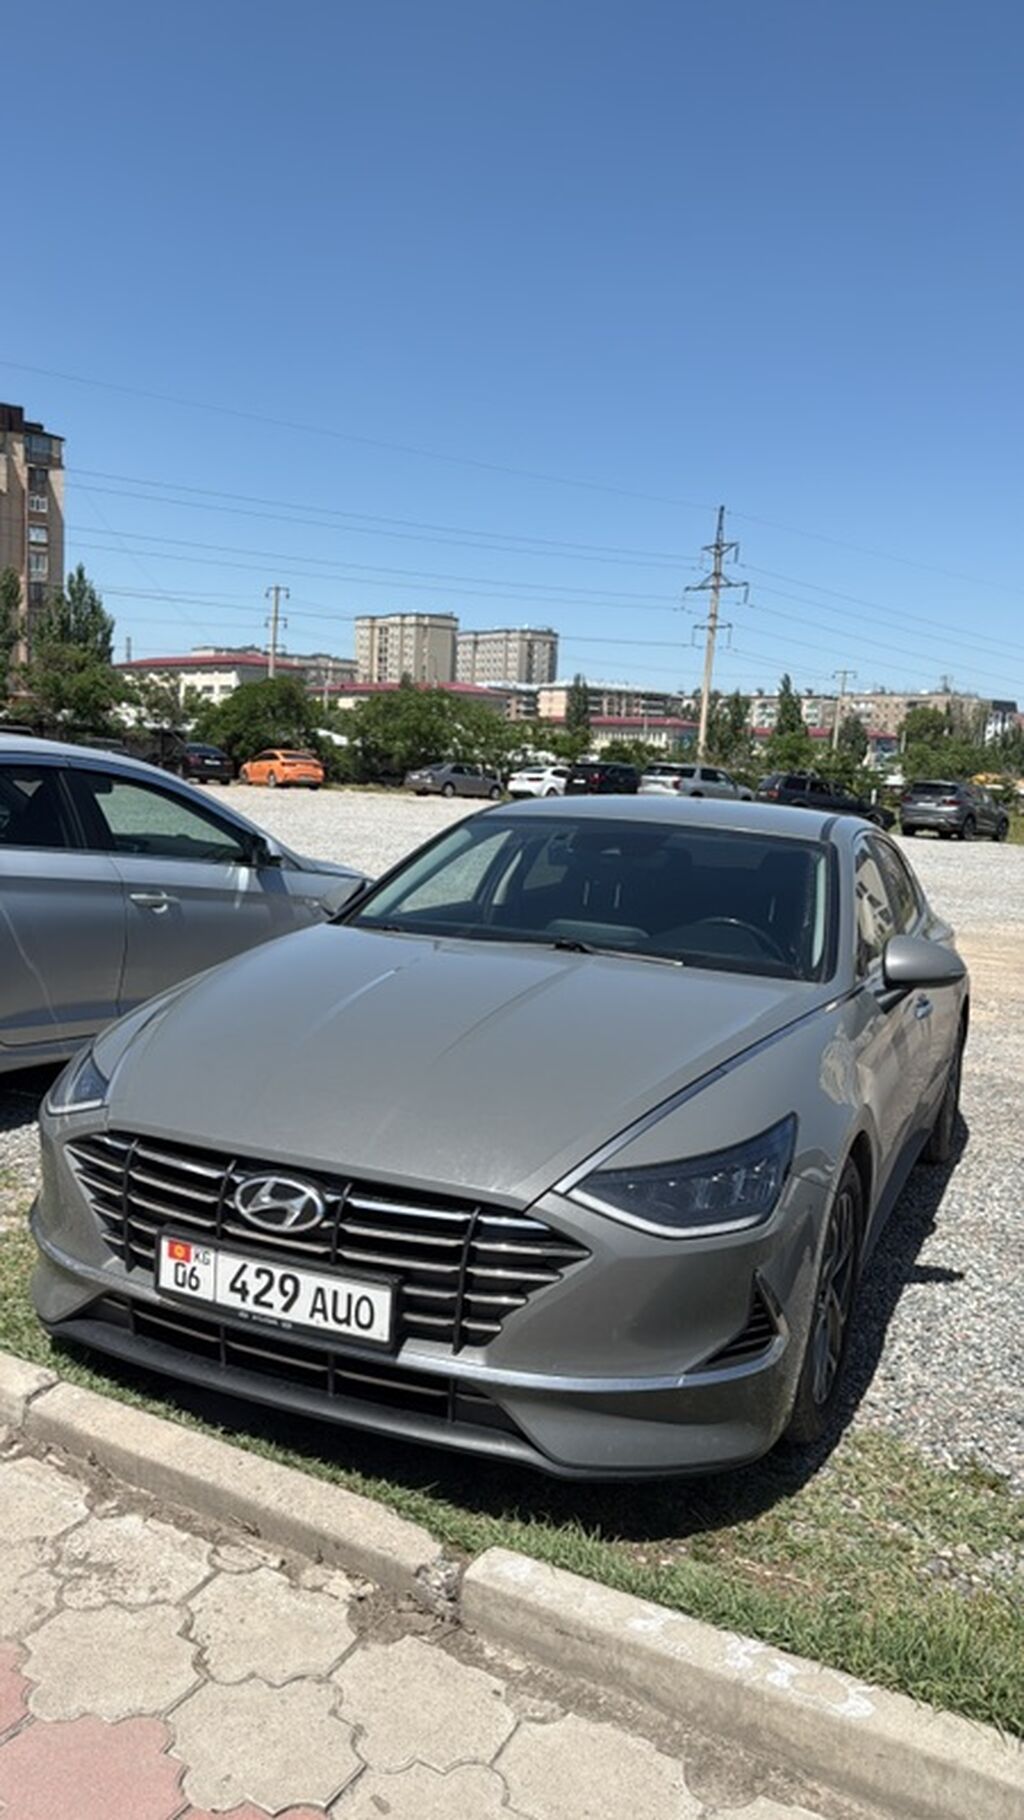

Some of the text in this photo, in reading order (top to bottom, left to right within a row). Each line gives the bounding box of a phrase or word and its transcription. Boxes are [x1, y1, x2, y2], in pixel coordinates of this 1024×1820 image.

[193, 1248, 211, 1266] KG
[174, 1261, 201, 1291] 06
[229, 1263, 301, 1314] 429
[309, 1286, 375, 1330] AUO
